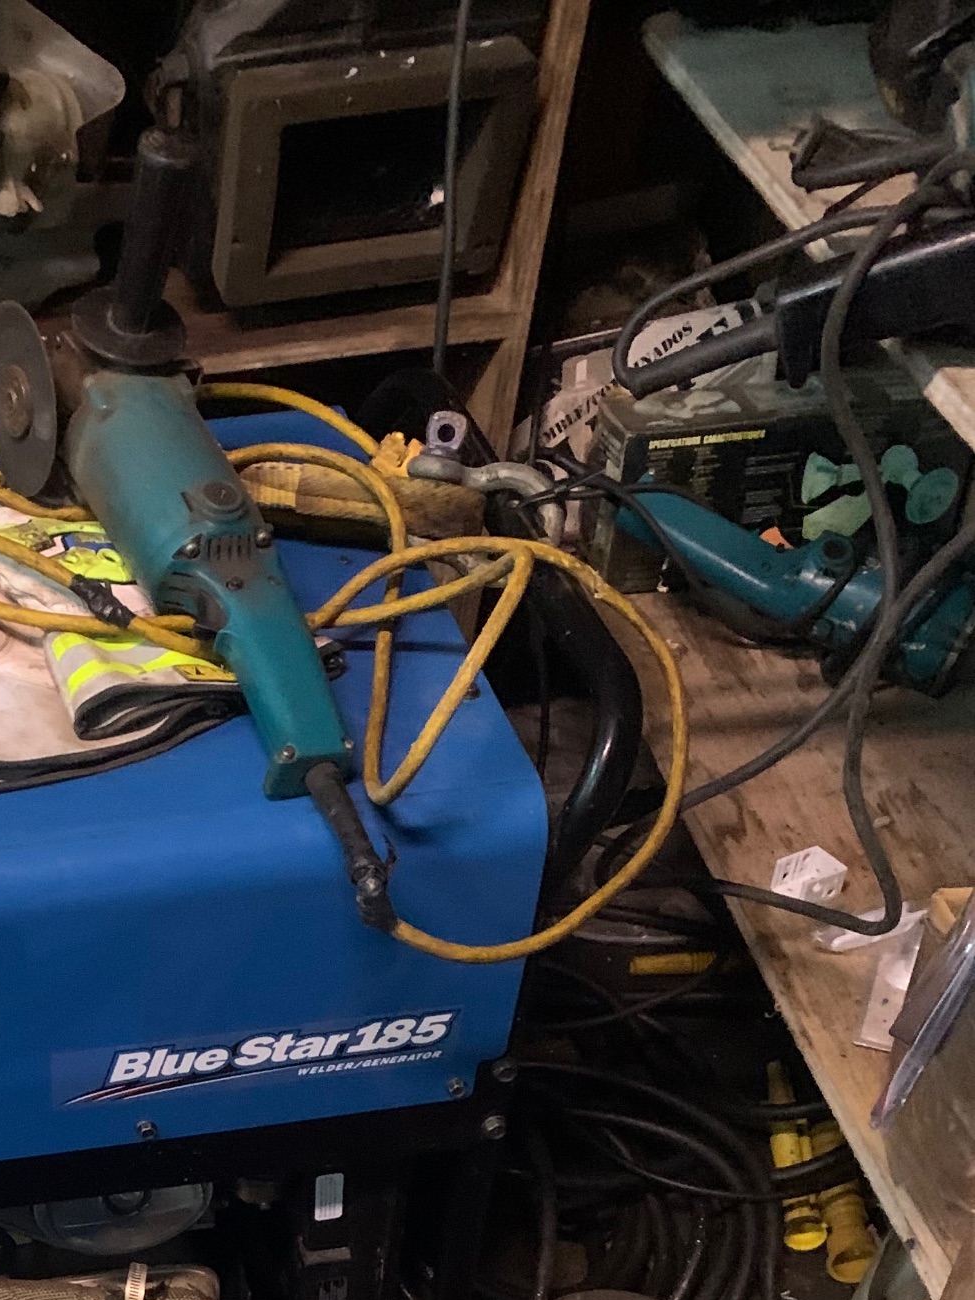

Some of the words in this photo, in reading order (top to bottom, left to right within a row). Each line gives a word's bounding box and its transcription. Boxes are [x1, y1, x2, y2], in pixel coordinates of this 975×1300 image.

[108, 1047, 228, 1084] Blue
[234, 1032, 350, 1067] Star
[347, 1013, 453, 1054] 185
[297, 1050, 443, 1077] WELDER/GENERATOR
